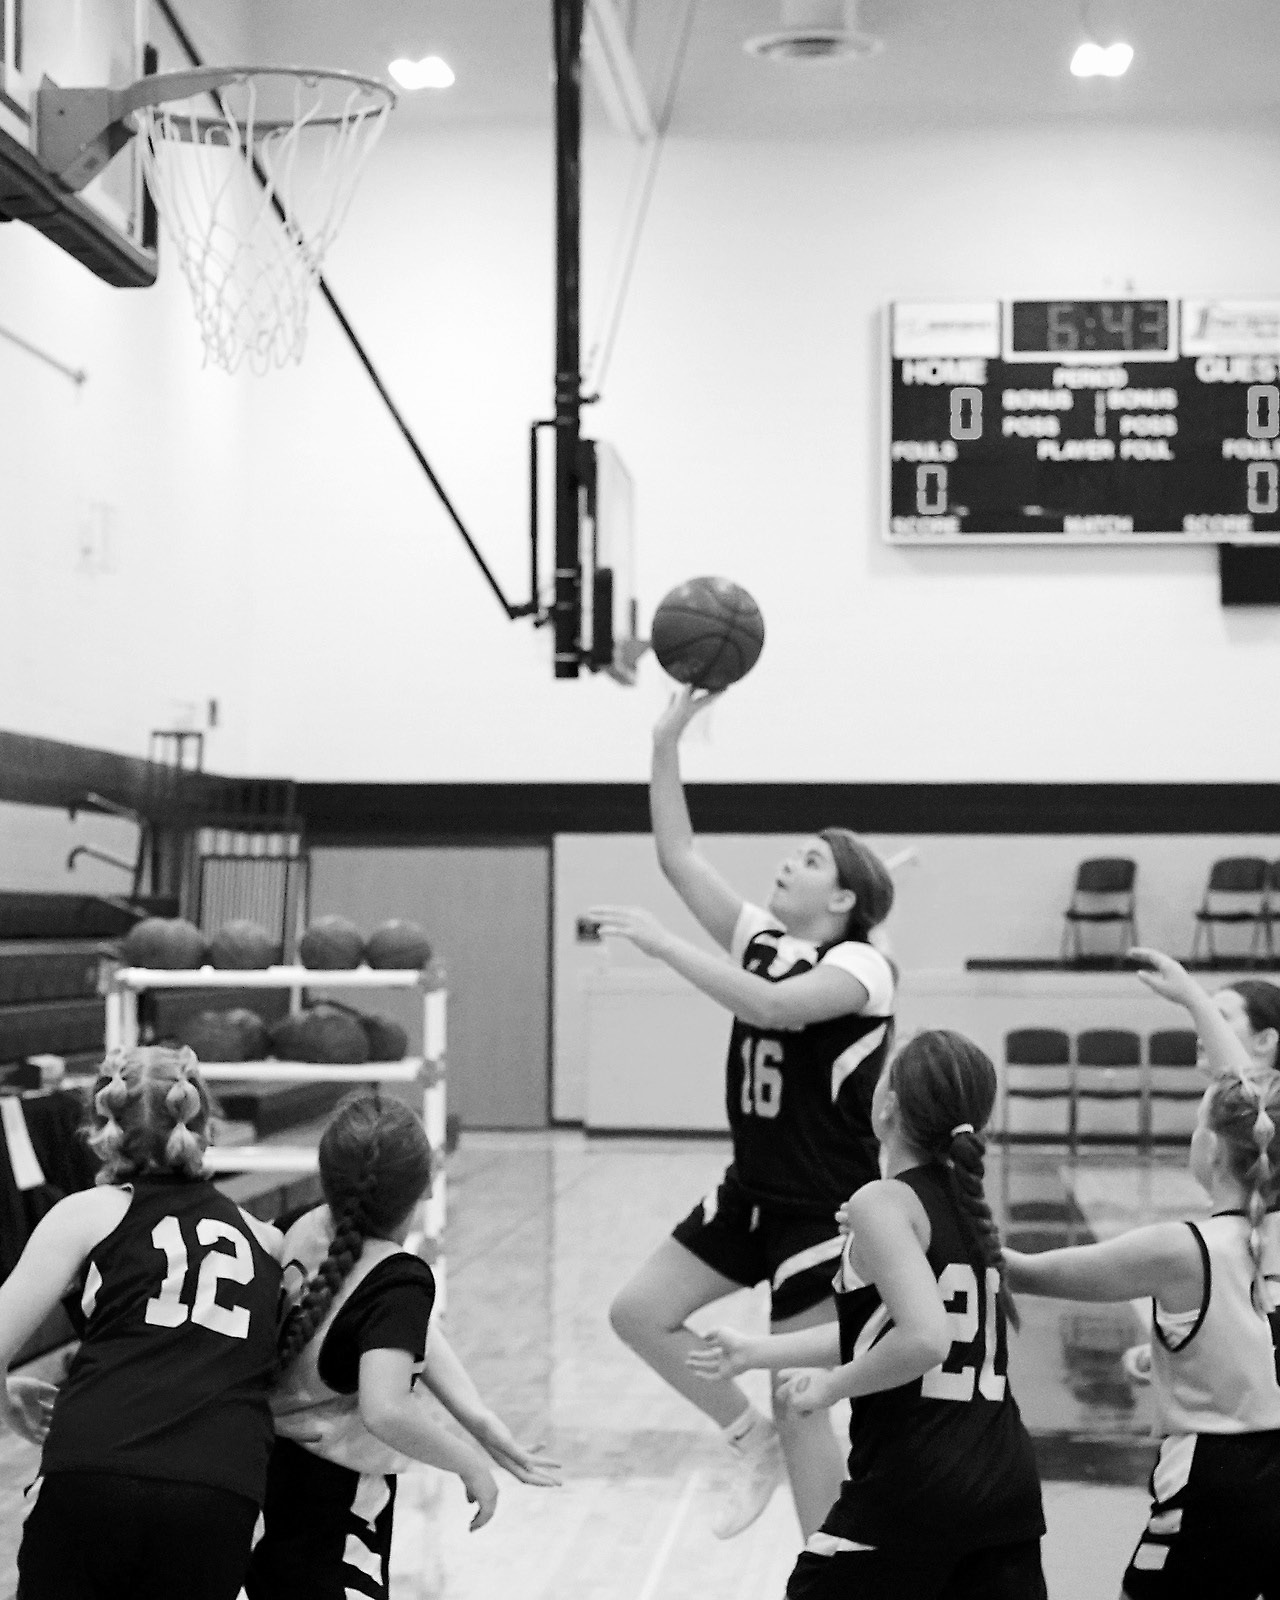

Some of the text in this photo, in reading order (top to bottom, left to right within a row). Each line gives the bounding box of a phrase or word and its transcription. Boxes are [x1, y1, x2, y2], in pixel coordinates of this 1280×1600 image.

[902, 358, 988, 385] HOME
[1195, 357, 1280, 383] GUES
[950, 387, 982, 440] 0
[1002, 389, 1074, 411] BONUS
[1106, 388, 1178, 410] BONUS
[1247, 385, 1279, 438] 0
[1036, 439, 1175, 461] PLAYER FOUL
[916, 464, 948, 515] 0
[1247, 462, 1279, 514] 0
[741, 1037, 784, 1119] 16
[145, 1215, 255, 1339] 12
